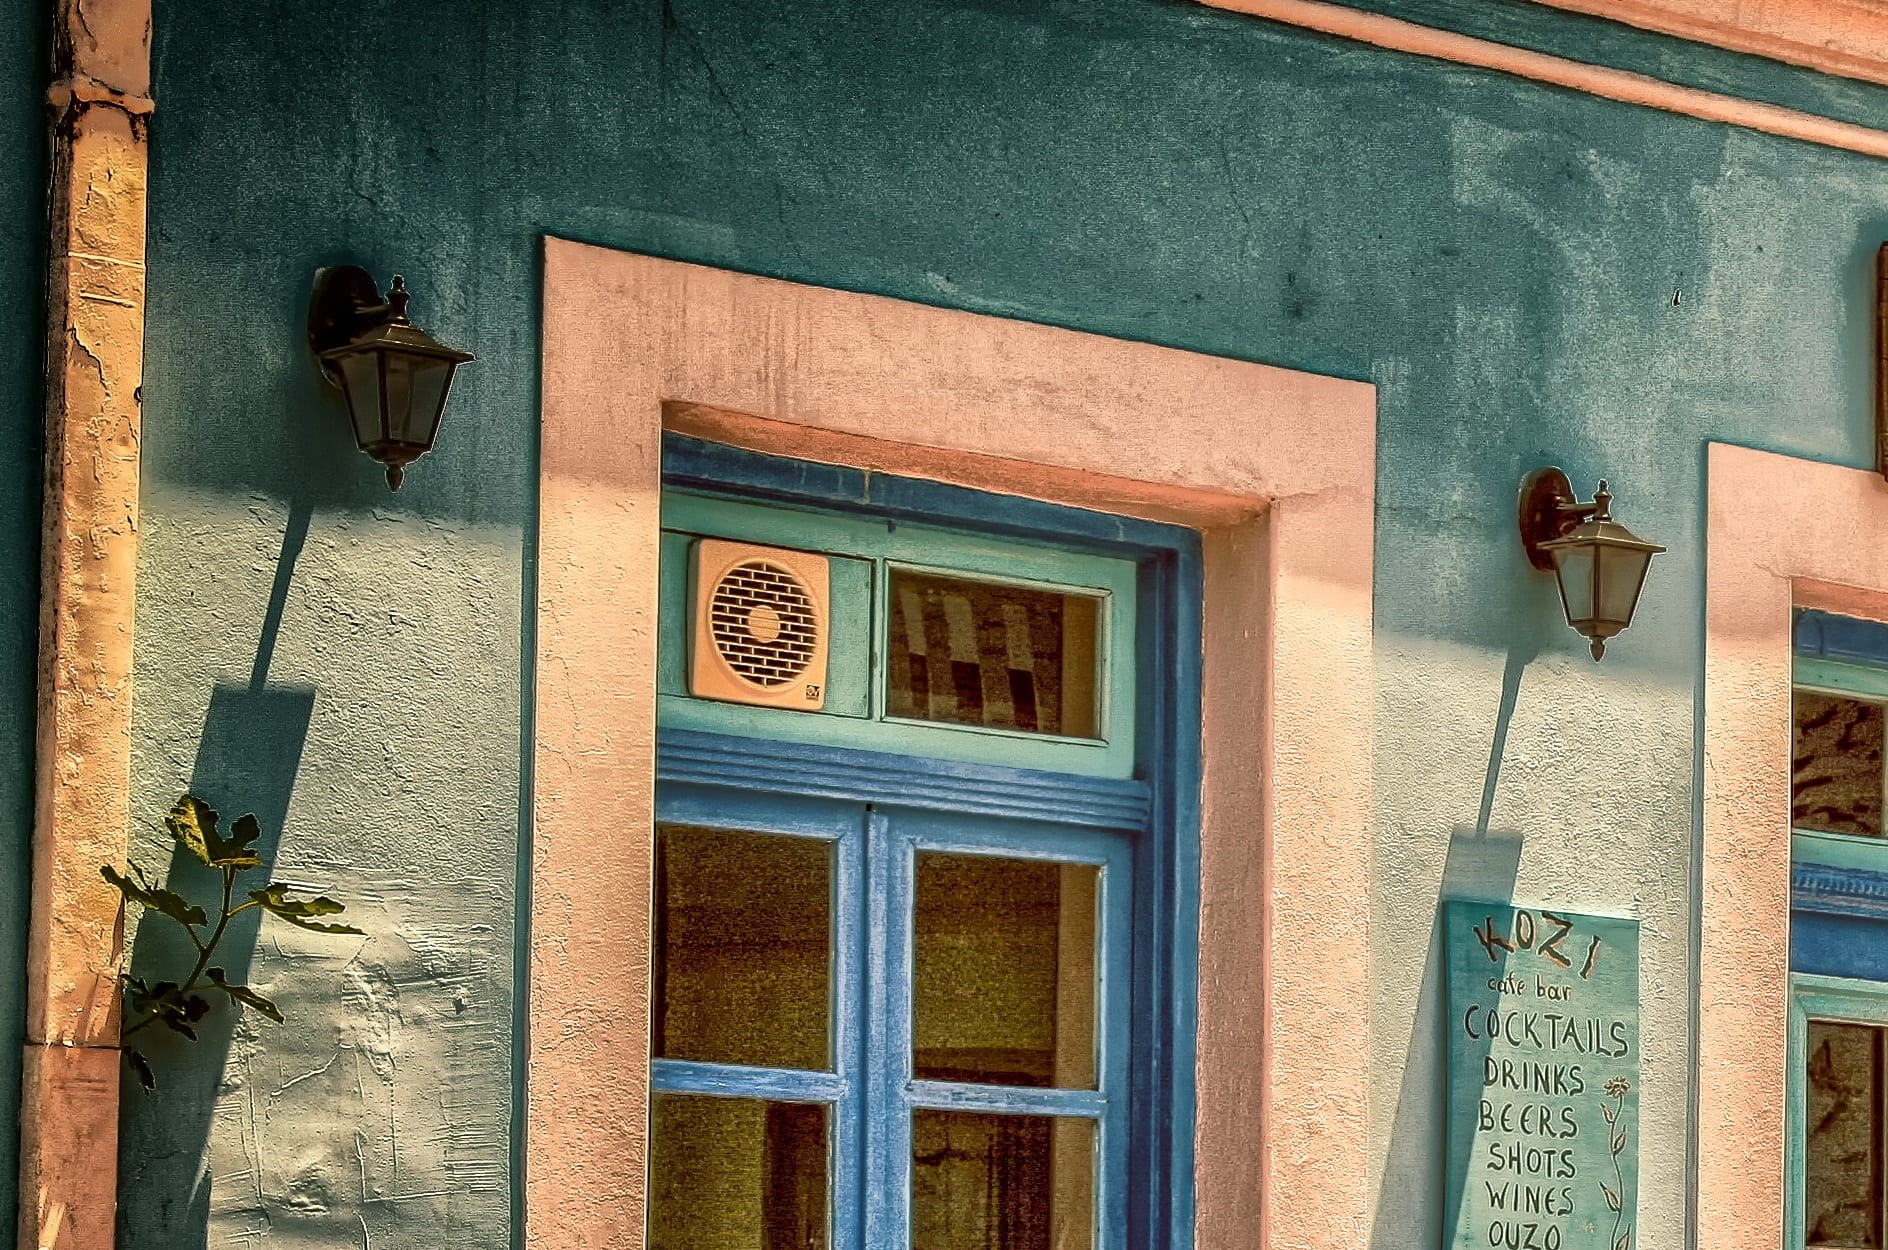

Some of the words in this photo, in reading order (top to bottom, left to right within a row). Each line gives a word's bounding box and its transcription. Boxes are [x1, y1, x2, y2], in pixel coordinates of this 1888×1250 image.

[1472, 909, 1602, 980] KOZI
[1487, 971, 1526, 996] cafe
[1536, 974, 1572, 1001] bar
[1464, 1004, 1629, 1058] COCKTAILS
[1482, 1055, 1585, 1096] DRINKS
[1478, 1099, 1579, 1140] BEERS
[1486, 1141, 1577, 1178] SHOTS
[1484, 1180, 1575, 1217] WINES
